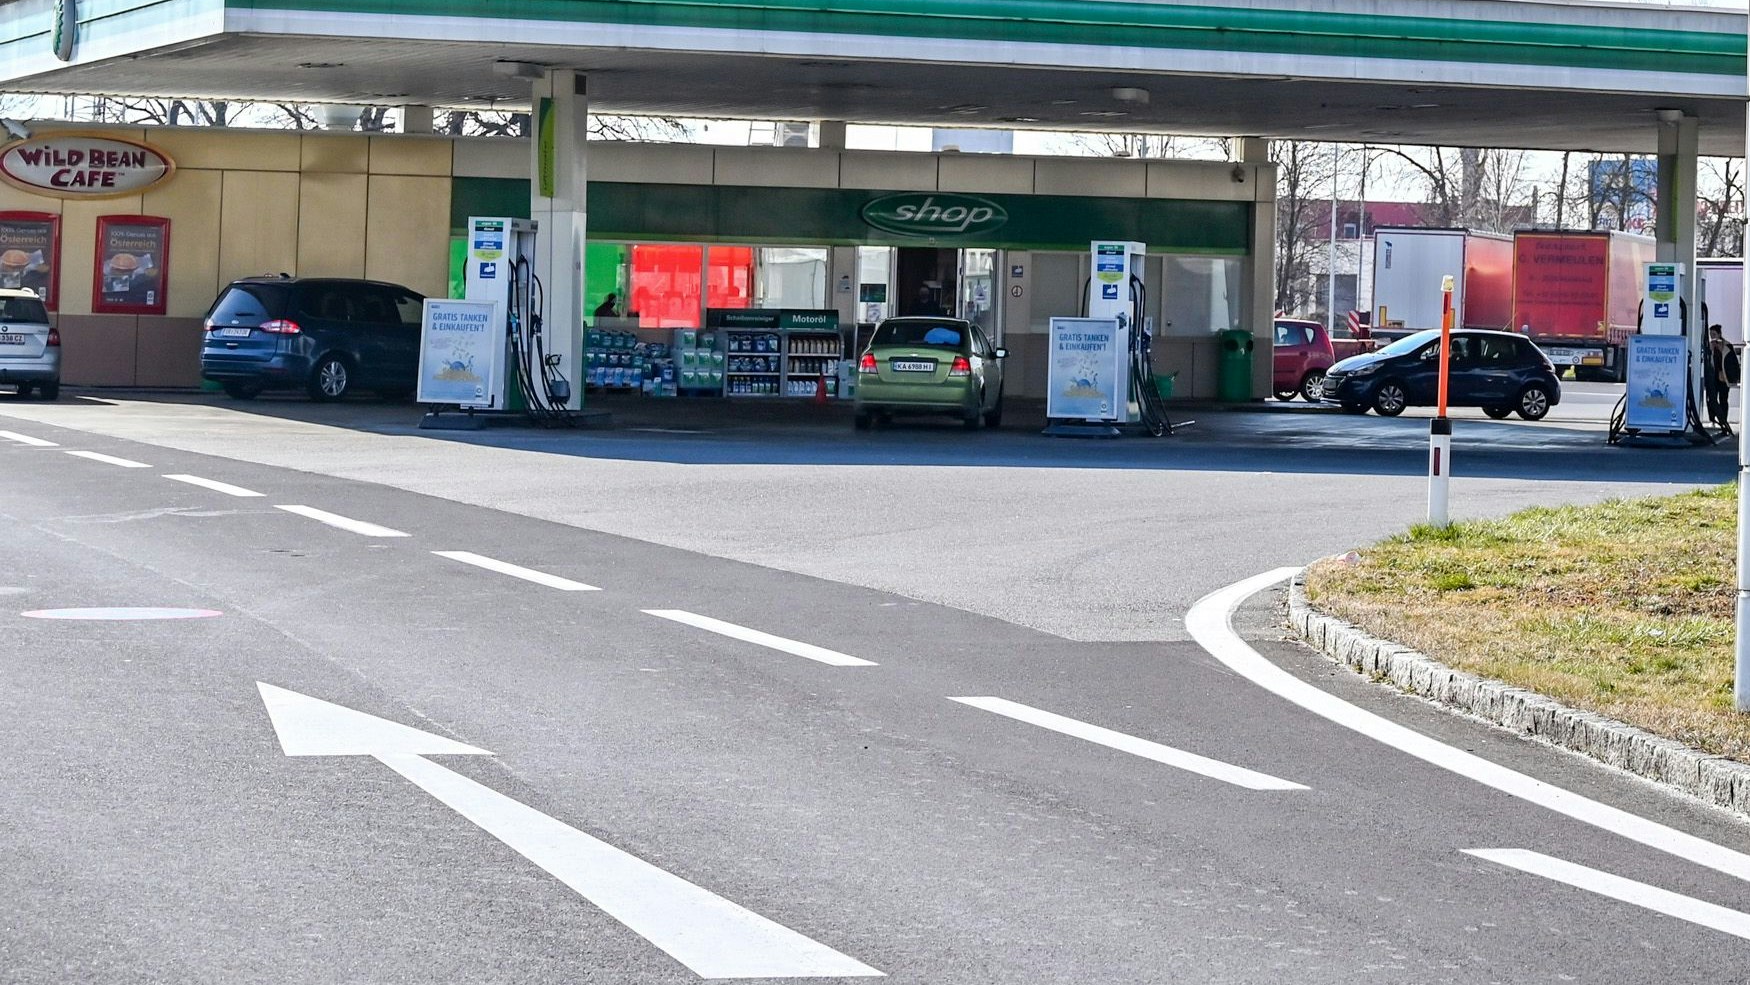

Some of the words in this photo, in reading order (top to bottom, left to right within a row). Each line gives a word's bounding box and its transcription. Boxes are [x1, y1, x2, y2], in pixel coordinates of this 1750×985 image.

[88, 148, 146, 168] BEAN
[50, 168, 117, 187] CAFE
[894, 197, 993, 232] shop
[432, 312, 458, 322] GRATIS
[460, 313, 488, 323] TANKEN
[792, 314, 826, 324] Motoröl
[1059, 333, 1082, 342] GRATIS
[1083, 334, 1109, 343] TANKEN
